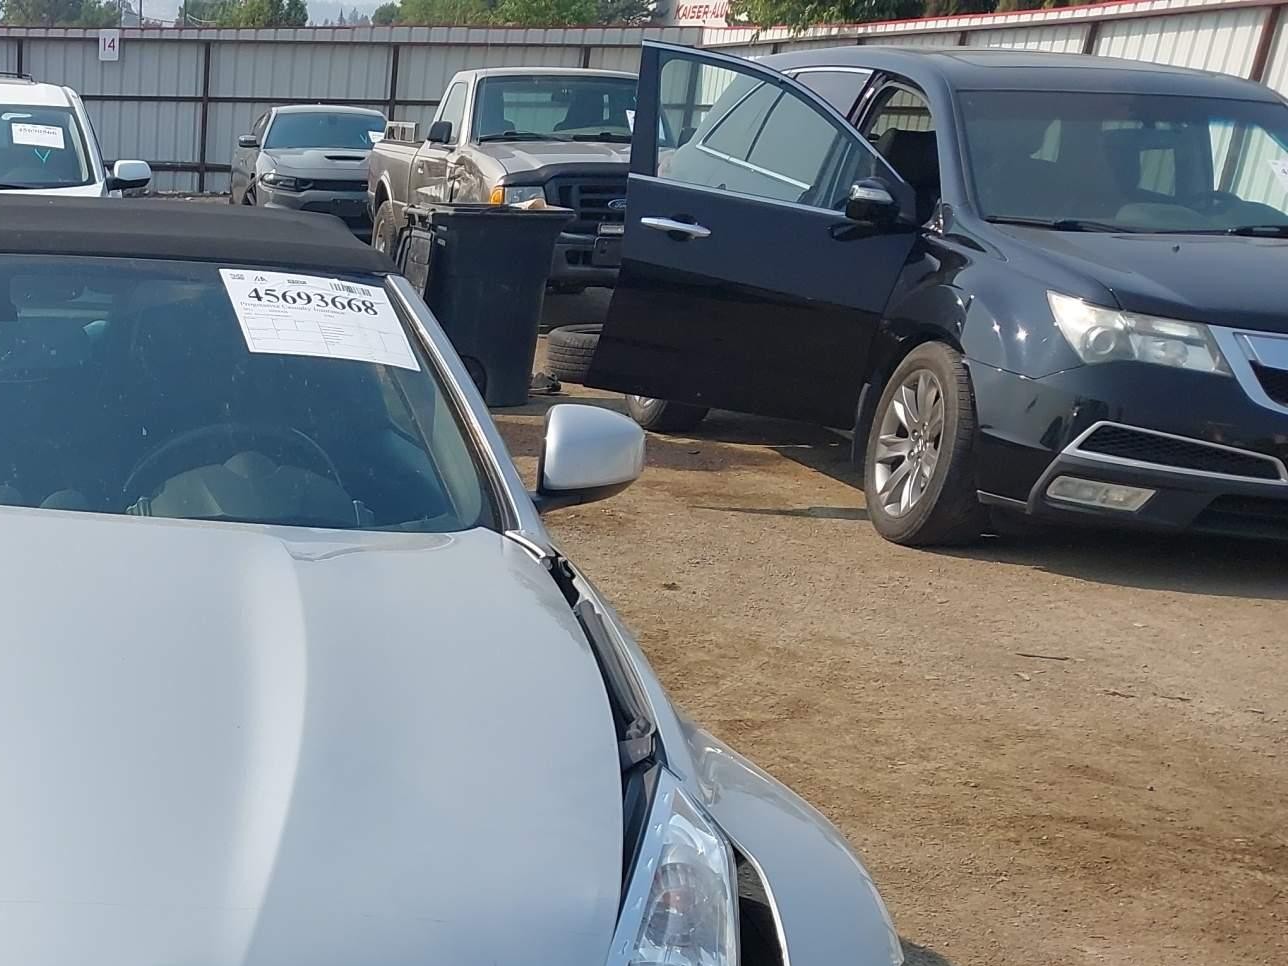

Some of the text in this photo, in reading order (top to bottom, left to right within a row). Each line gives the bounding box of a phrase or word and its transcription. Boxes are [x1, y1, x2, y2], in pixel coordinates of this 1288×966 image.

[674, 2, 728, 20] KAISER-ALU
[103, 38, 116, 52] 14
[248, 287, 378, 317] 45693668
